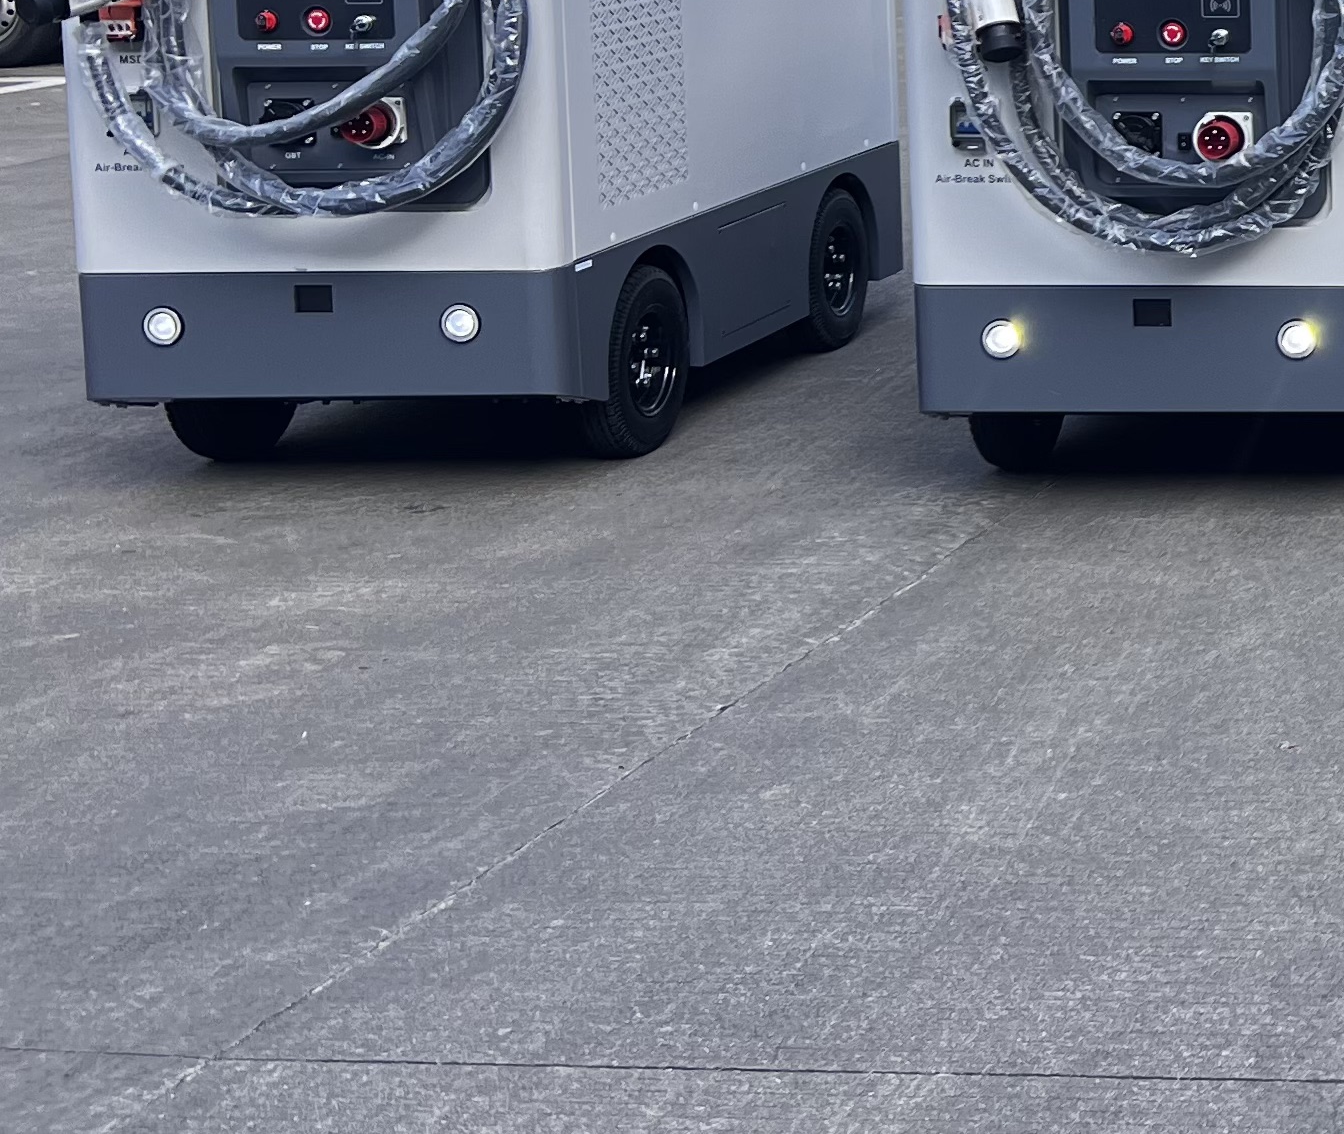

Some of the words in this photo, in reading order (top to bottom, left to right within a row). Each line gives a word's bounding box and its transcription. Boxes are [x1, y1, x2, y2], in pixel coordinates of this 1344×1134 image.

[310, 43, 329, 51] STOP
[284, 151, 302, 159] GBT
[94, 162, 143, 172] Air-Brea
[964, 158, 980, 167] AC
[983, 158, 995, 167] IN
[935, 174, 986, 184] Air-Break
